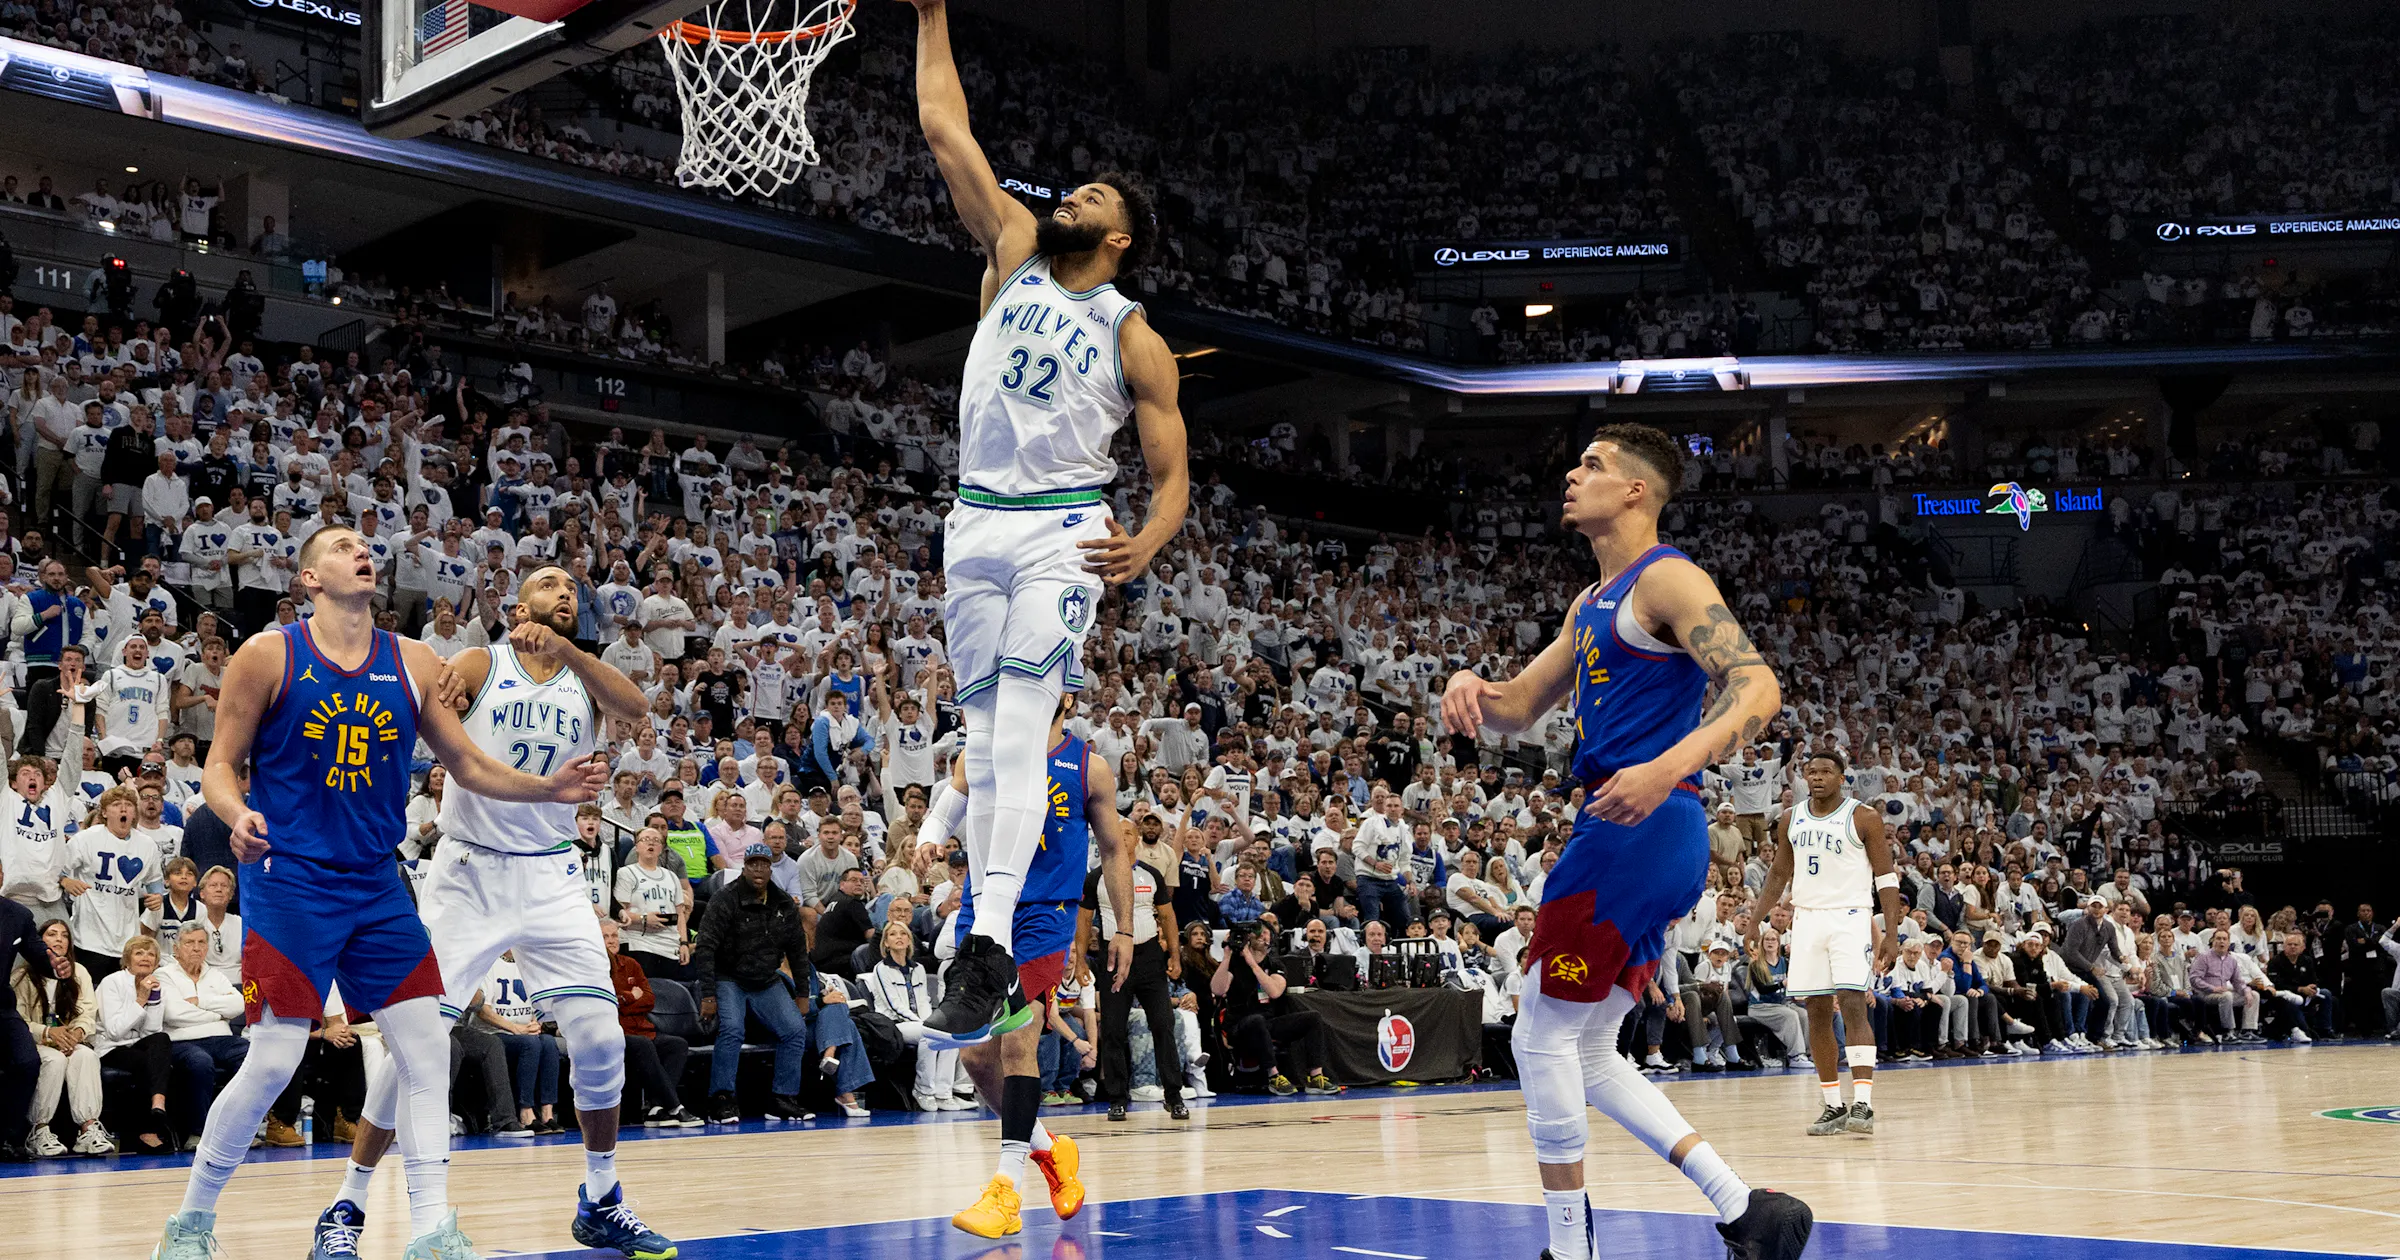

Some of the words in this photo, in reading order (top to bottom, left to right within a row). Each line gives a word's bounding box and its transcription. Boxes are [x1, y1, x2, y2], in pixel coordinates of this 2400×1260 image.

[2270, 220, 2344, 234] EXPERIENCE
[2346, 218, 2400, 231] AMAZING
[1461, 249, 1530, 262] LEXUS
[1542, 246, 1614, 259] EXPERIENCE
[1616, 244, 1669, 256] AMAZING
[34, 266, 72, 290] 111
[997, 301, 1101, 378] WOLVES
[239, 361, 248, 373] I
[1000, 345, 1062, 406] 32
[595, 376, 626, 396] 112
[272, 424, 282, 436] I
[83, 434, 93, 447] I
[263, 485, 271, 496] 5
[532, 494, 539, 506] I
[1912, 493, 1981, 516] Treasure
[2054, 488, 2104, 512] Island
[198, 534, 210, 550] I
[252, 532, 262, 546] I
[534, 545, 544, 558] I
[18, 570, 38, 579] WOLV
[437, 560, 449, 576] I
[437, 575, 464, 586] WOLVES
[870, 590, 876, 602] I
[806, 606, 814, 616] I
[1157, 622, 1163, 634] I
[907, 646, 916, 658] I
[1580, 624, 1611, 685] HIGH
[1415, 662, 1423, 673] I
[368, 672, 398, 682] ibotta
[1393, 670, 1400, 680] I
[1220, 682, 1227, 692] I
[1330, 676, 1338, 688] I
[117, 686, 153, 704] WOLVES
[786, 686, 796, 700] I
[128, 704, 139, 725] 5
[302, 692, 348, 740] MILE
[354, 692, 398, 742] HIGH
[951, 714, 958, 726] 9
[490, 700, 582, 747] WOLVES
[1557, 716, 1565, 728] I
[899, 728, 908, 744] I
[335, 724, 370, 766] 15
[508, 740, 560, 777] 27
[696, 752, 714, 760] WOLV
[1389, 751, 1405, 764] 21
[1054, 758, 1078, 771] ibotta
[325, 766, 372, 793] CITY
[1742, 770, 1750, 781] I
[1229, 784, 1248, 792] WOLVE
[1717, 779, 1725, 792] I
[1416, 798, 1426, 811] I
[17, 798, 34, 828] I
[16, 826, 58, 843] WOLVES
[1792, 830, 1843, 855] WOLVES
[686, 846, 694, 859] 1
[2262, 854, 2284, 862] CLUB
[95, 851, 116, 882] I
[1808, 856, 1820, 876] 5
[1192, 876, 1198, 890] 1
[1416, 872, 1424, 884] 5
[94, 881, 136, 896] WOLVES
[642, 884, 676, 903] WOLVE
[591, 888, 600, 904] 5
[496, 978, 511, 1005] I
[495, 1006, 532, 1017] WOLVE
